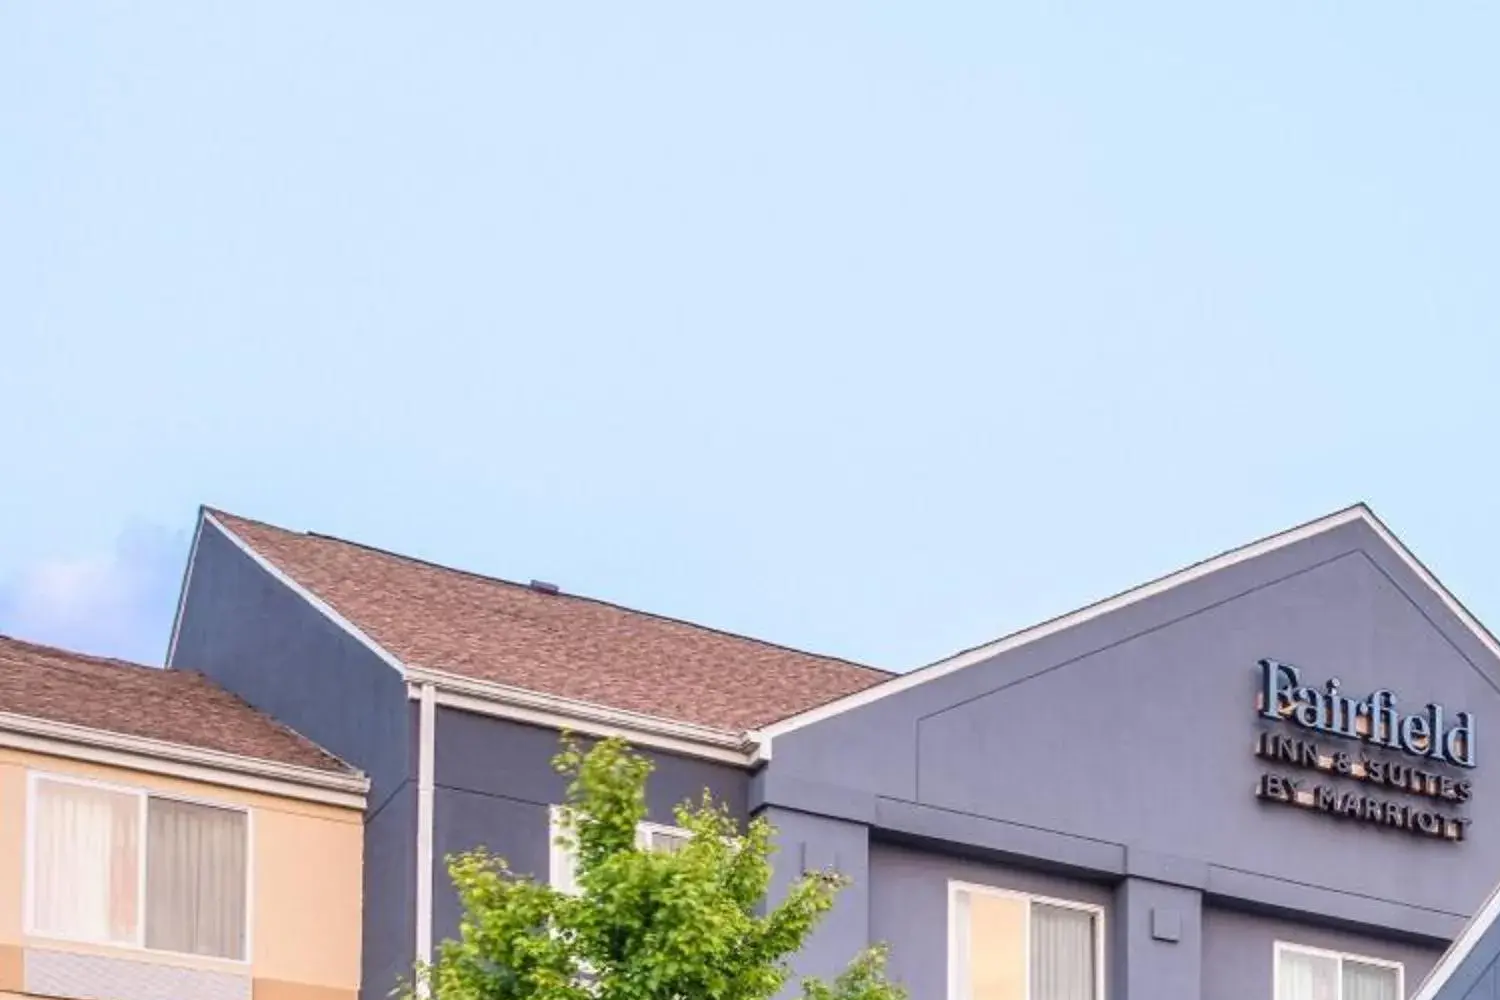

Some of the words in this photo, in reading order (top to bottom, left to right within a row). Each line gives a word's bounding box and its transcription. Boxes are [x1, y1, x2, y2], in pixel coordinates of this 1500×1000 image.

[1257, 657, 1477, 768] Fairfield
[1255, 732, 1320, 766] INN
[1335, 751, 1352, 775] &
[1363, 757, 1472, 804] SUITES
[1255, 773, 1304, 802] BY
[1314, 782, 1472, 842] MARRIOTT
